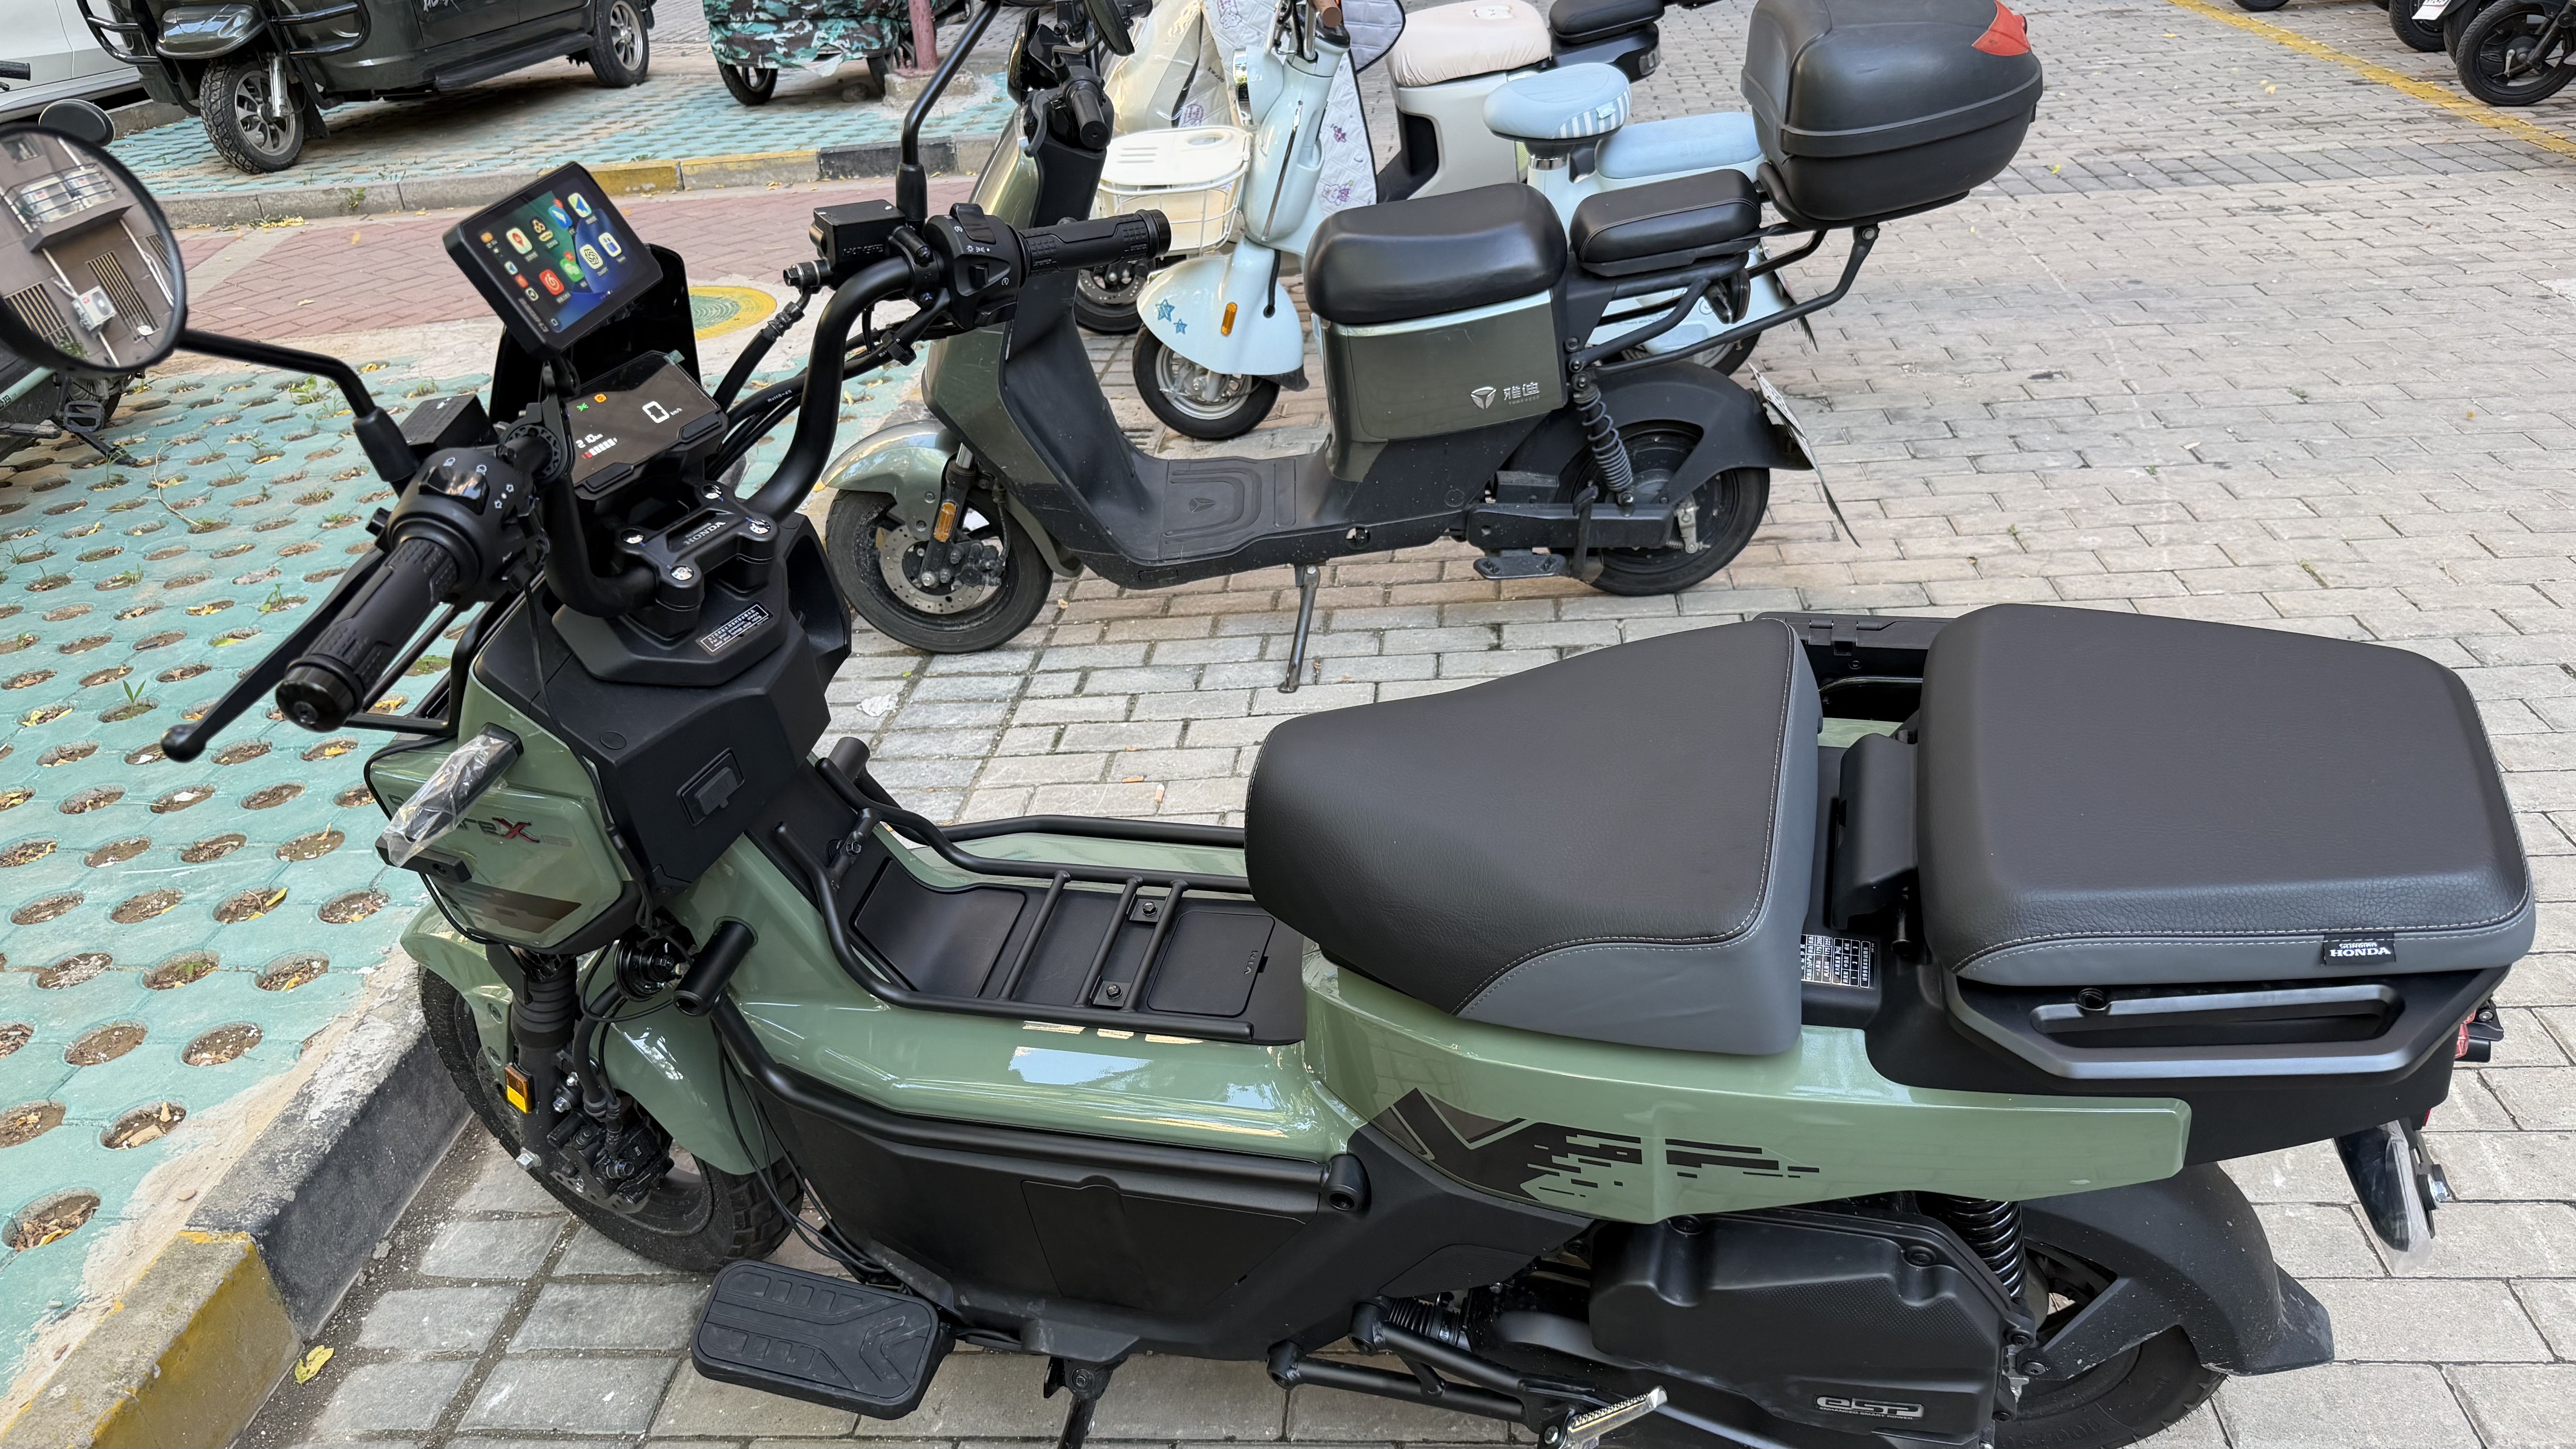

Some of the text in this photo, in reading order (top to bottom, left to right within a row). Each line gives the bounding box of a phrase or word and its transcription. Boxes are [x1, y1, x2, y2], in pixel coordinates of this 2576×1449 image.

[642, 401, 670, 423] 0
[683, 521, 726, 545] HONDA
[1244, 950, 1258, 974] VIN
[2329, 947, 2391, 957] HONDA
[1819, 1407, 1858, 1415] ENHANCED
